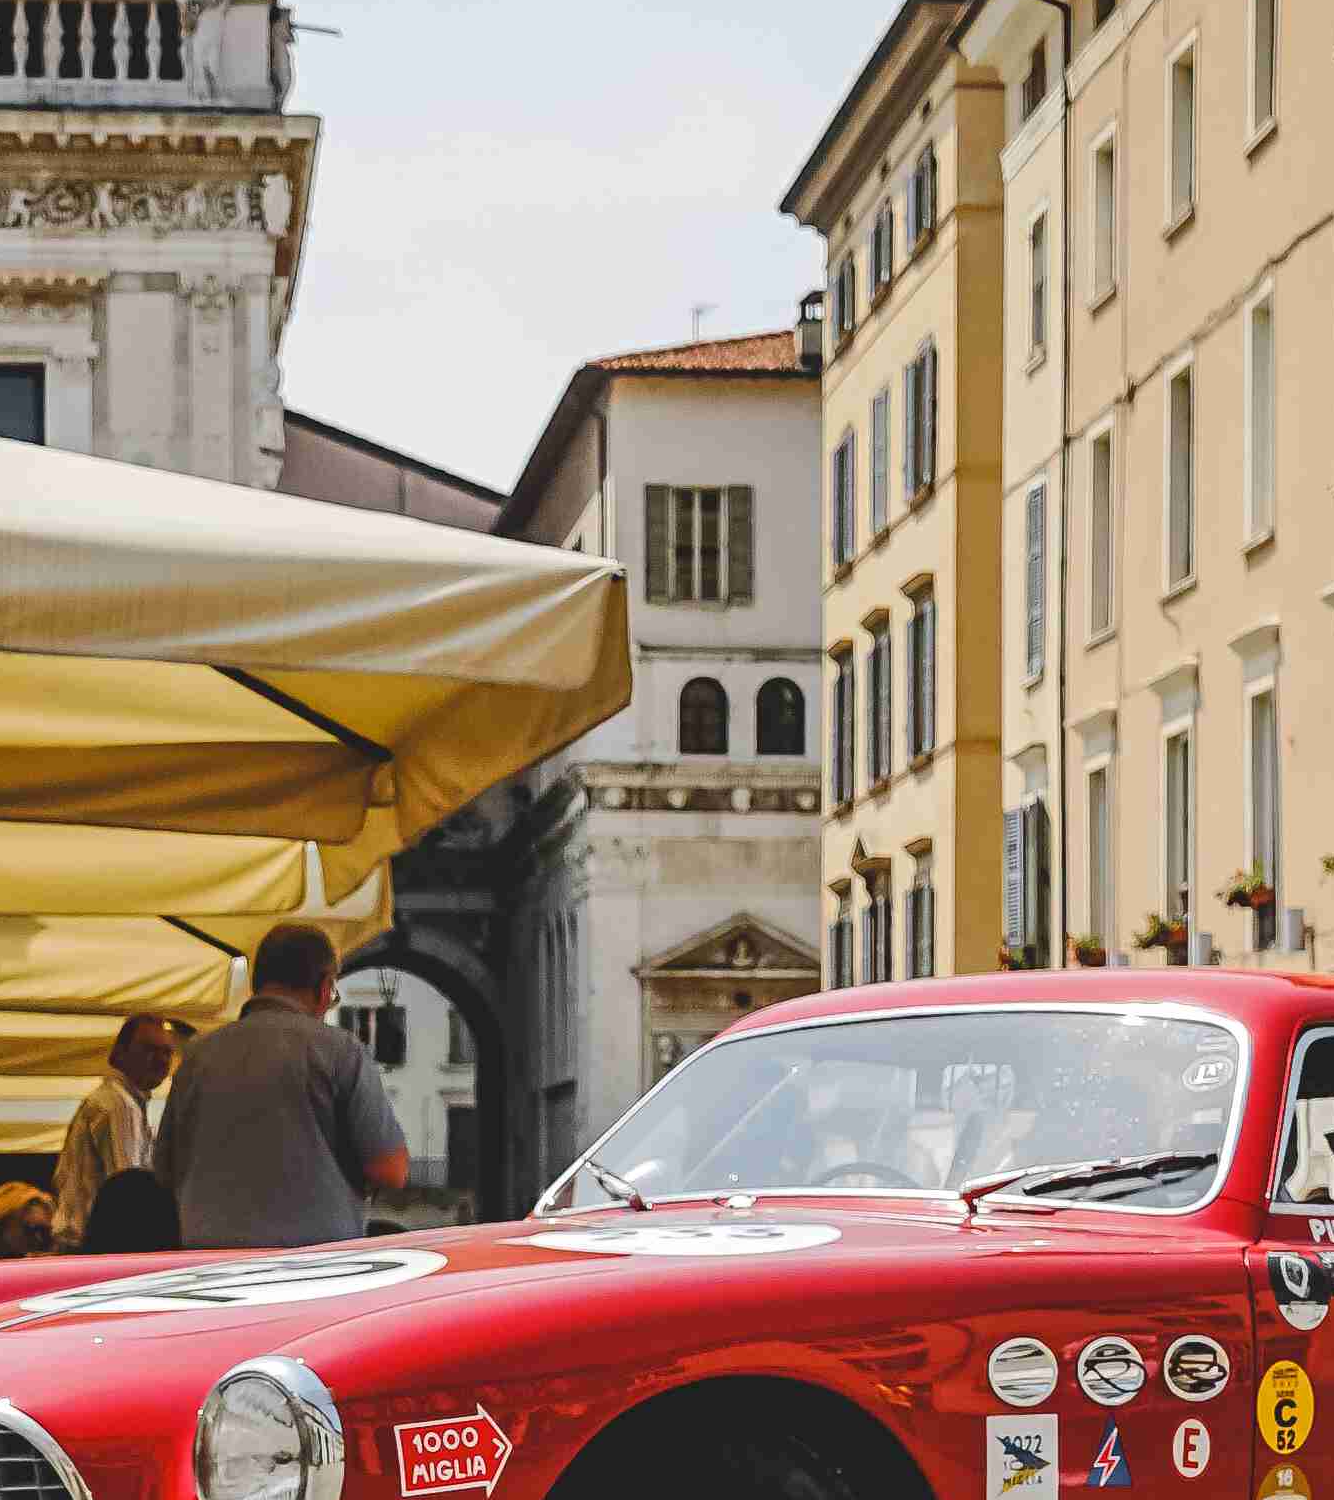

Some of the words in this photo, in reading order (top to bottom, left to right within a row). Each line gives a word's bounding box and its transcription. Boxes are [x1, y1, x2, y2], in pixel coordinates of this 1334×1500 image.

[1274, 1398, 1298, 1428] C
[412, 1426, 479, 1454] 1000
[1182, 1427, 1200, 1469] E
[1276, 1430, 1296, 1450] 52
[412, 1455, 487, 1485] MIGLIA
